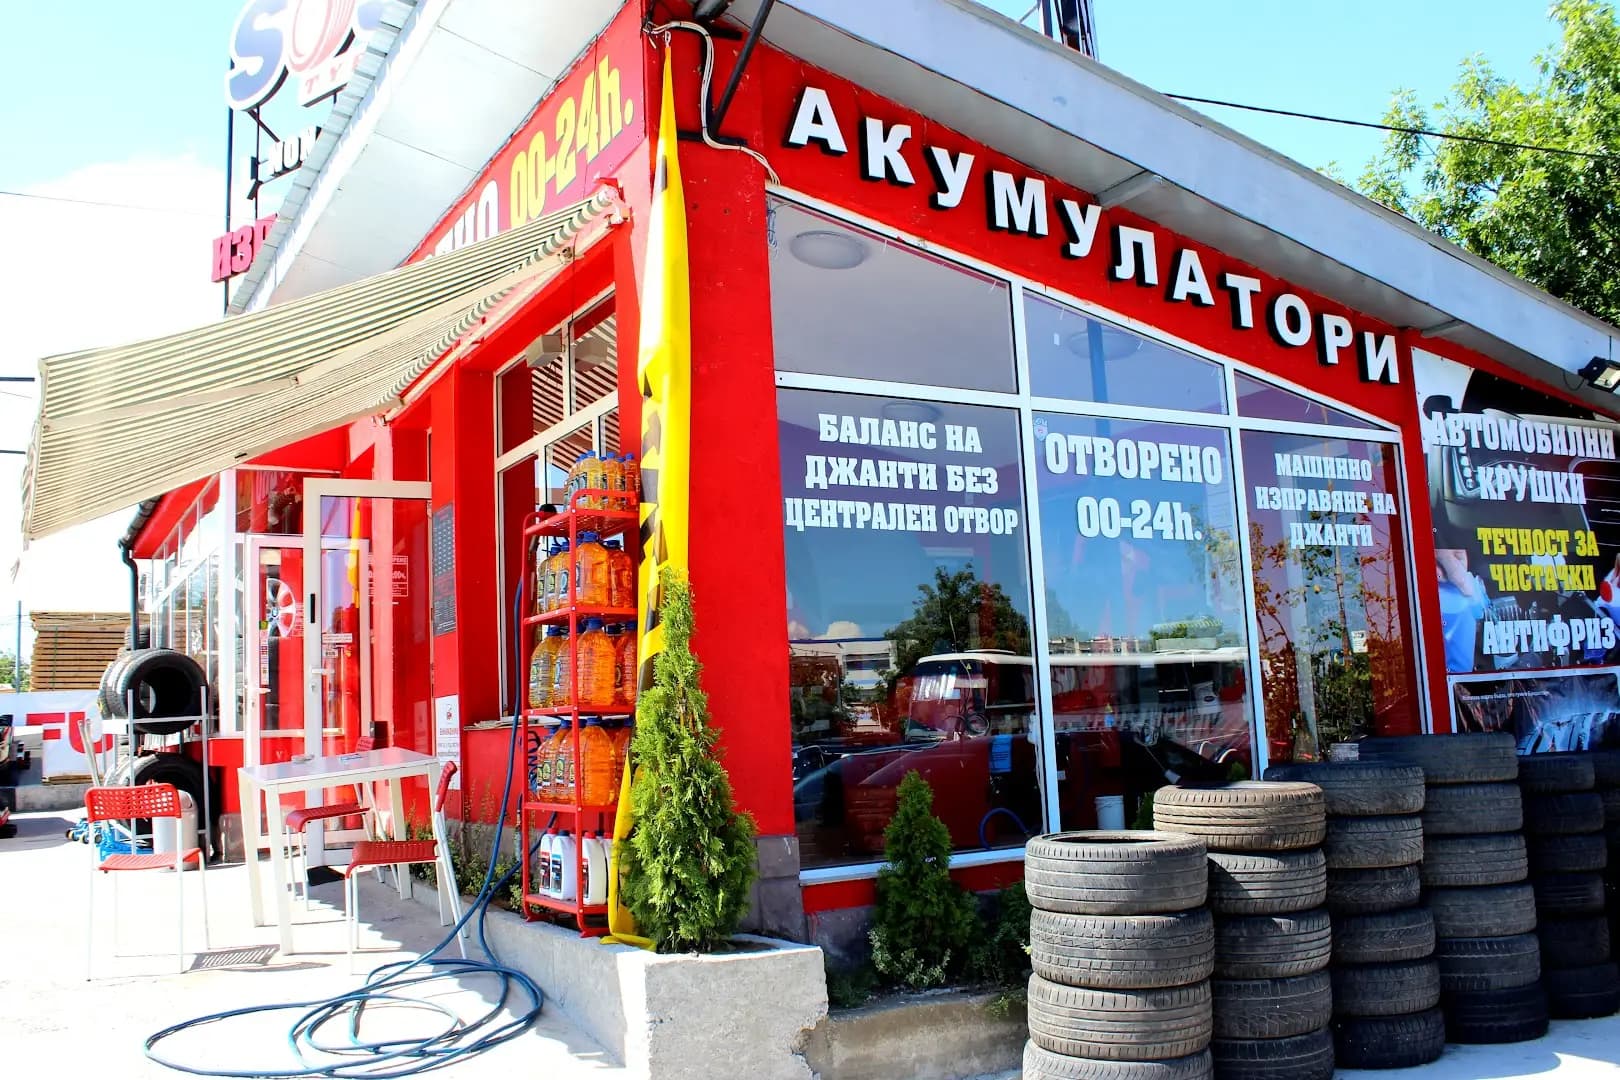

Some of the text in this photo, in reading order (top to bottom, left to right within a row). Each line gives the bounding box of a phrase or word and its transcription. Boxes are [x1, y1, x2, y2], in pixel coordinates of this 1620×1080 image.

[227, 0, 384, 103] SO
[510, 55, 635, 229] 00-24h.
[788, 86, 1401, 384] АКУМУЛАТОРИ
[818, 413, 983, 454] БАЛАНС НА
[1431, 410, 1616, 460] АВТОМОБИЛНИ
[805, 455, 999, 495] ДЖАНТИ БЕЗ
[1045, 432, 1223, 485] ОТВОРЕНО
[1274, 453, 1373, 482] МАШИННО
[1255, 486, 1398, 516] ИЗПРАВЯНЕ НА
[1477, 465, 1587, 505] КРУШКИ
[784, 497, 1019, 536] ЦЕНТРАЛЕН ОТВОР
[1077, 496, 1203, 542] 00-24h.
[1289, 522, 1374, 550] ДЖАНТИ
[1476, 527, 1600, 557] ТЕЧНОСТ ЗА
[1489, 564, 1597, 592] ЧИСТАЧКИ
[1482, 614, 1617, 656] АНТИФРИЗ
